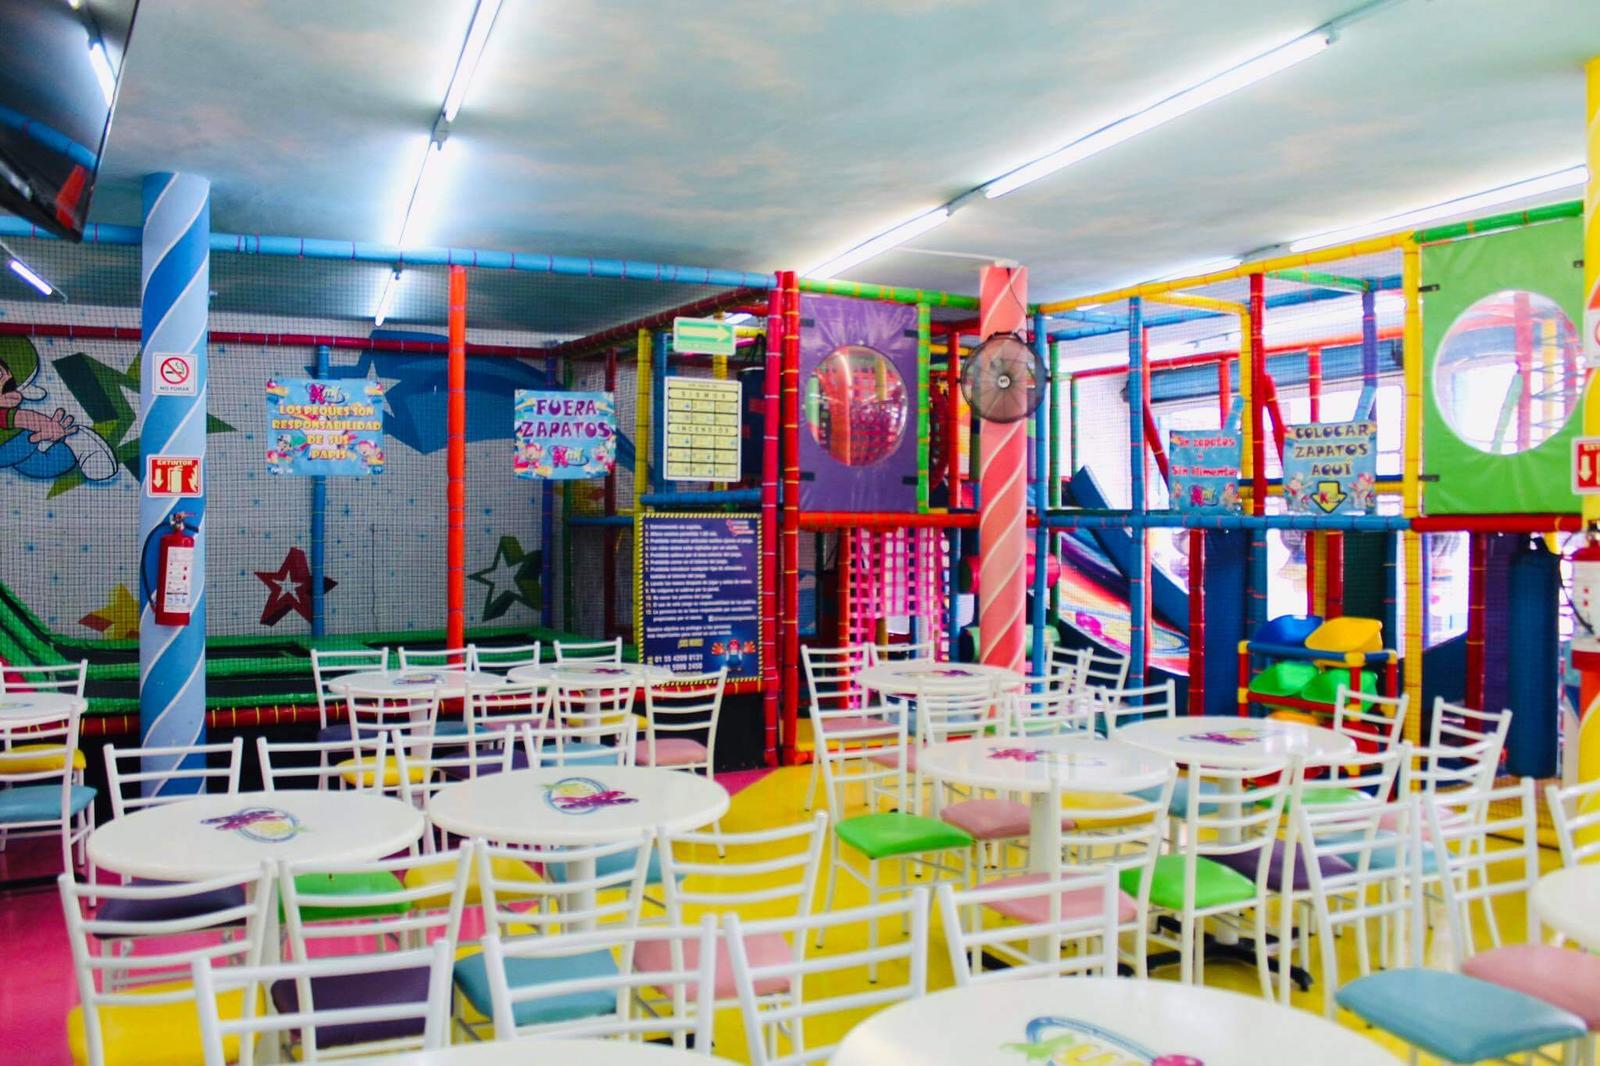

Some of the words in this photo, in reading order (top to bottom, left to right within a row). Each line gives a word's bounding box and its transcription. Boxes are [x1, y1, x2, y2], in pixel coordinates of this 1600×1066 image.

[279, 404, 302, 416] LOS
[536, 399, 597, 416] FUERA
[272, 420, 382, 431] RESPONSABILIDAD
[521, 421, 611, 438] ZAPATOS
[1295, 424, 1369, 440] COLOCAR
[307, 435, 324, 445] DE
[1295, 443, 1368, 459] ZAPATOS
